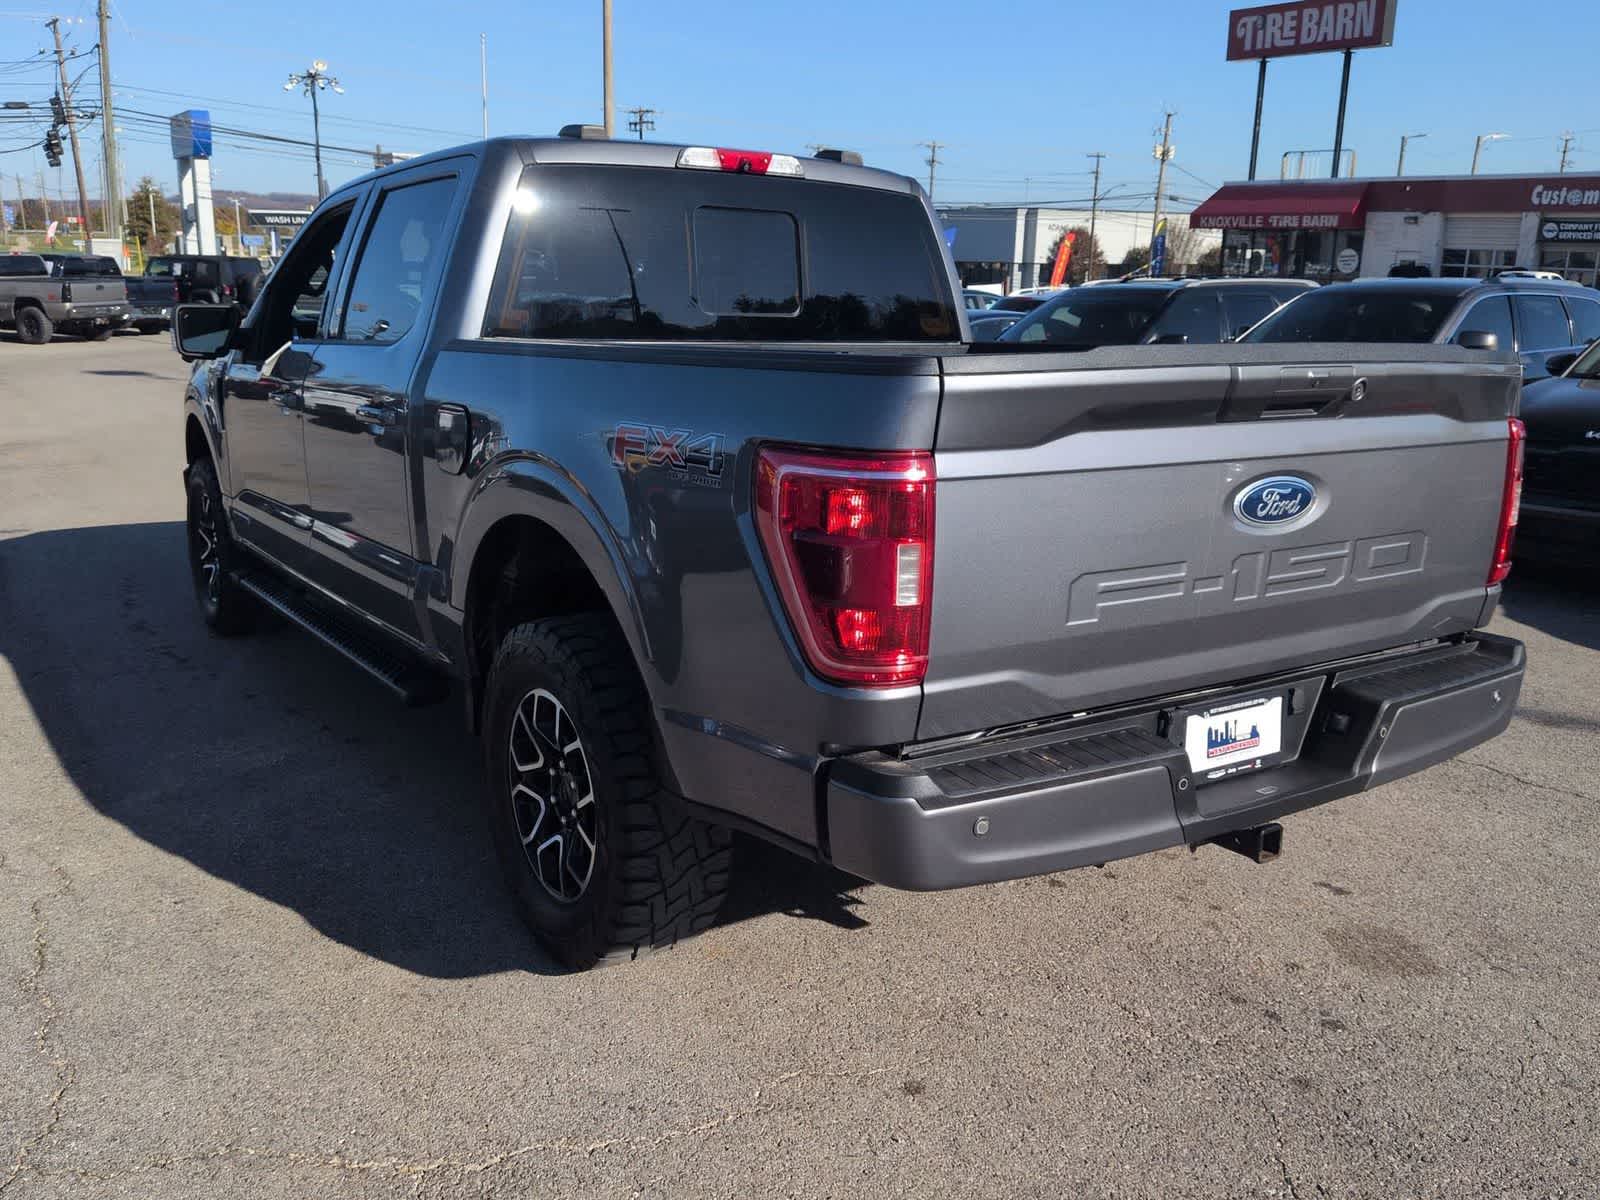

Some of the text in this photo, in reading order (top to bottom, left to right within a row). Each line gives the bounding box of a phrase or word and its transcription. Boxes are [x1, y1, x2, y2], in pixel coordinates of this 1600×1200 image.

[1300, 0, 1377, 45] BARN
[264, 215, 307, 225] WASH UN
[1200, 216, 1263, 227] KNOXVILLE
[1301, 215, 1339, 227] BARN
[610, 420, 727, 481] FX4
[1256, 487, 1302, 518] Ford
[1065, 529, 1429, 626] F-150
